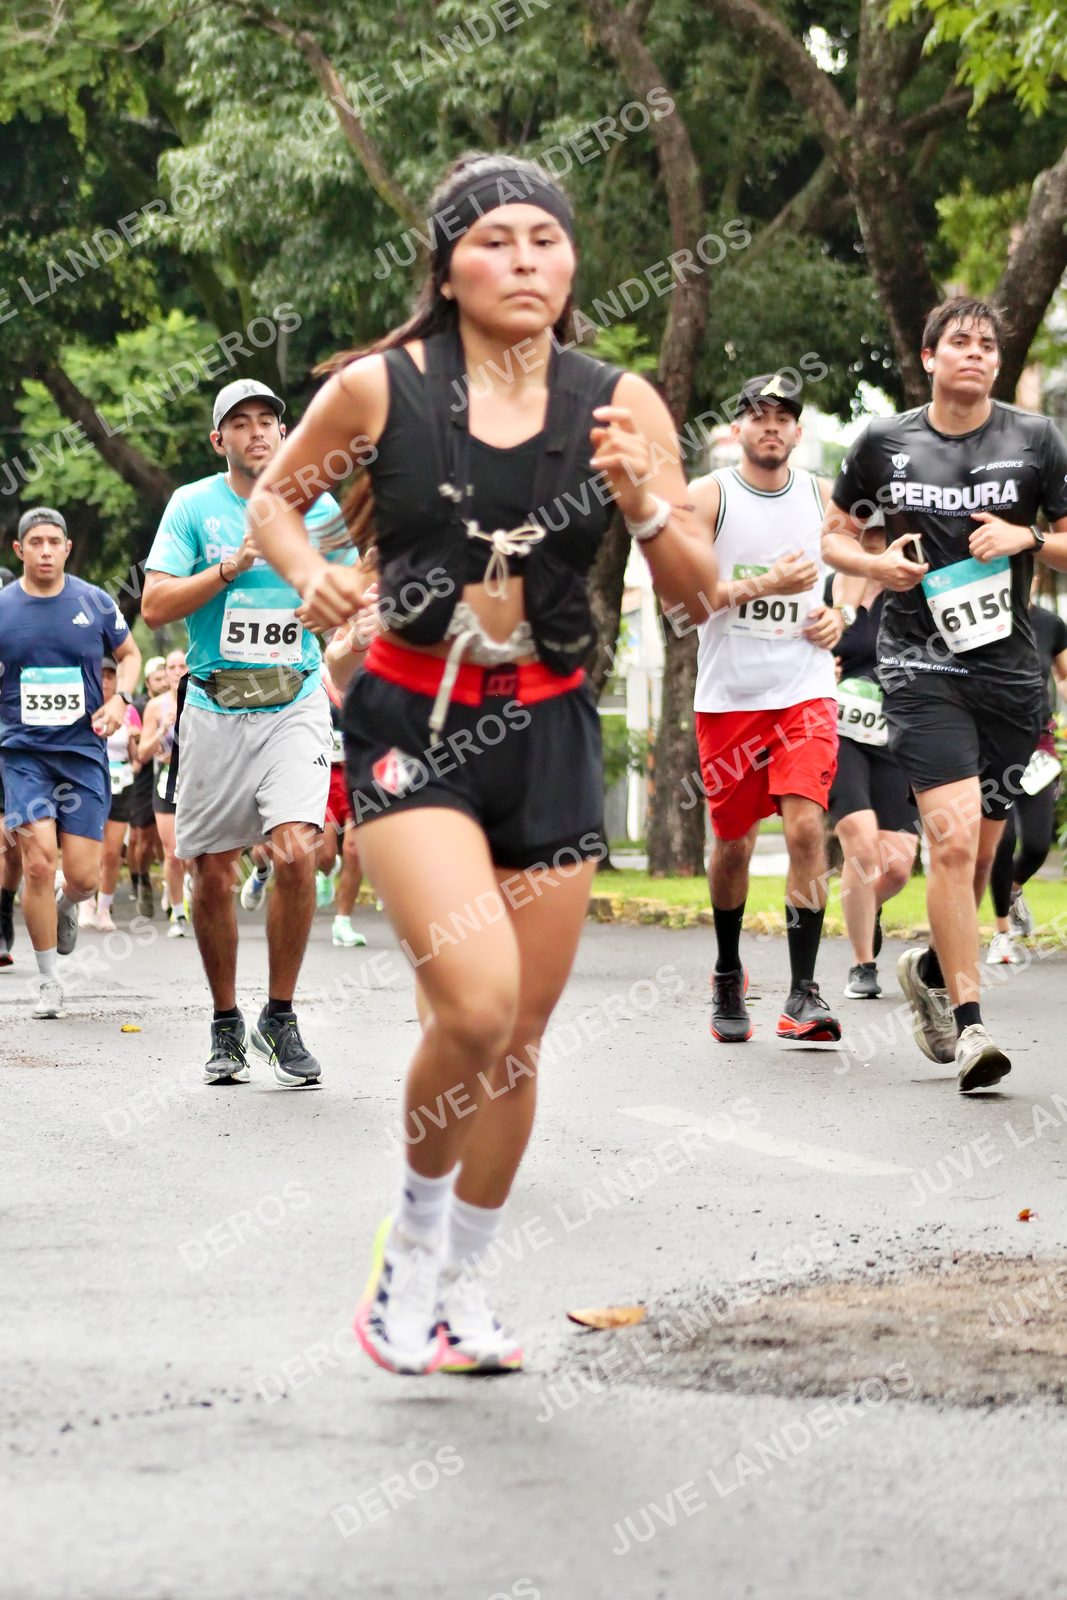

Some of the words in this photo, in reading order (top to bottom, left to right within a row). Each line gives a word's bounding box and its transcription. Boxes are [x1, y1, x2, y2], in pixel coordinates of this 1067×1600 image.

[986, 460, 1024, 471] BROOKS
[890, 479, 1019, 510] PERDURA
[739, 600, 799, 623] 1901
[226, 621, 298, 645] 5186
[26, 694, 80, 711] 3393
[838, 704, 888, 731] 1907
